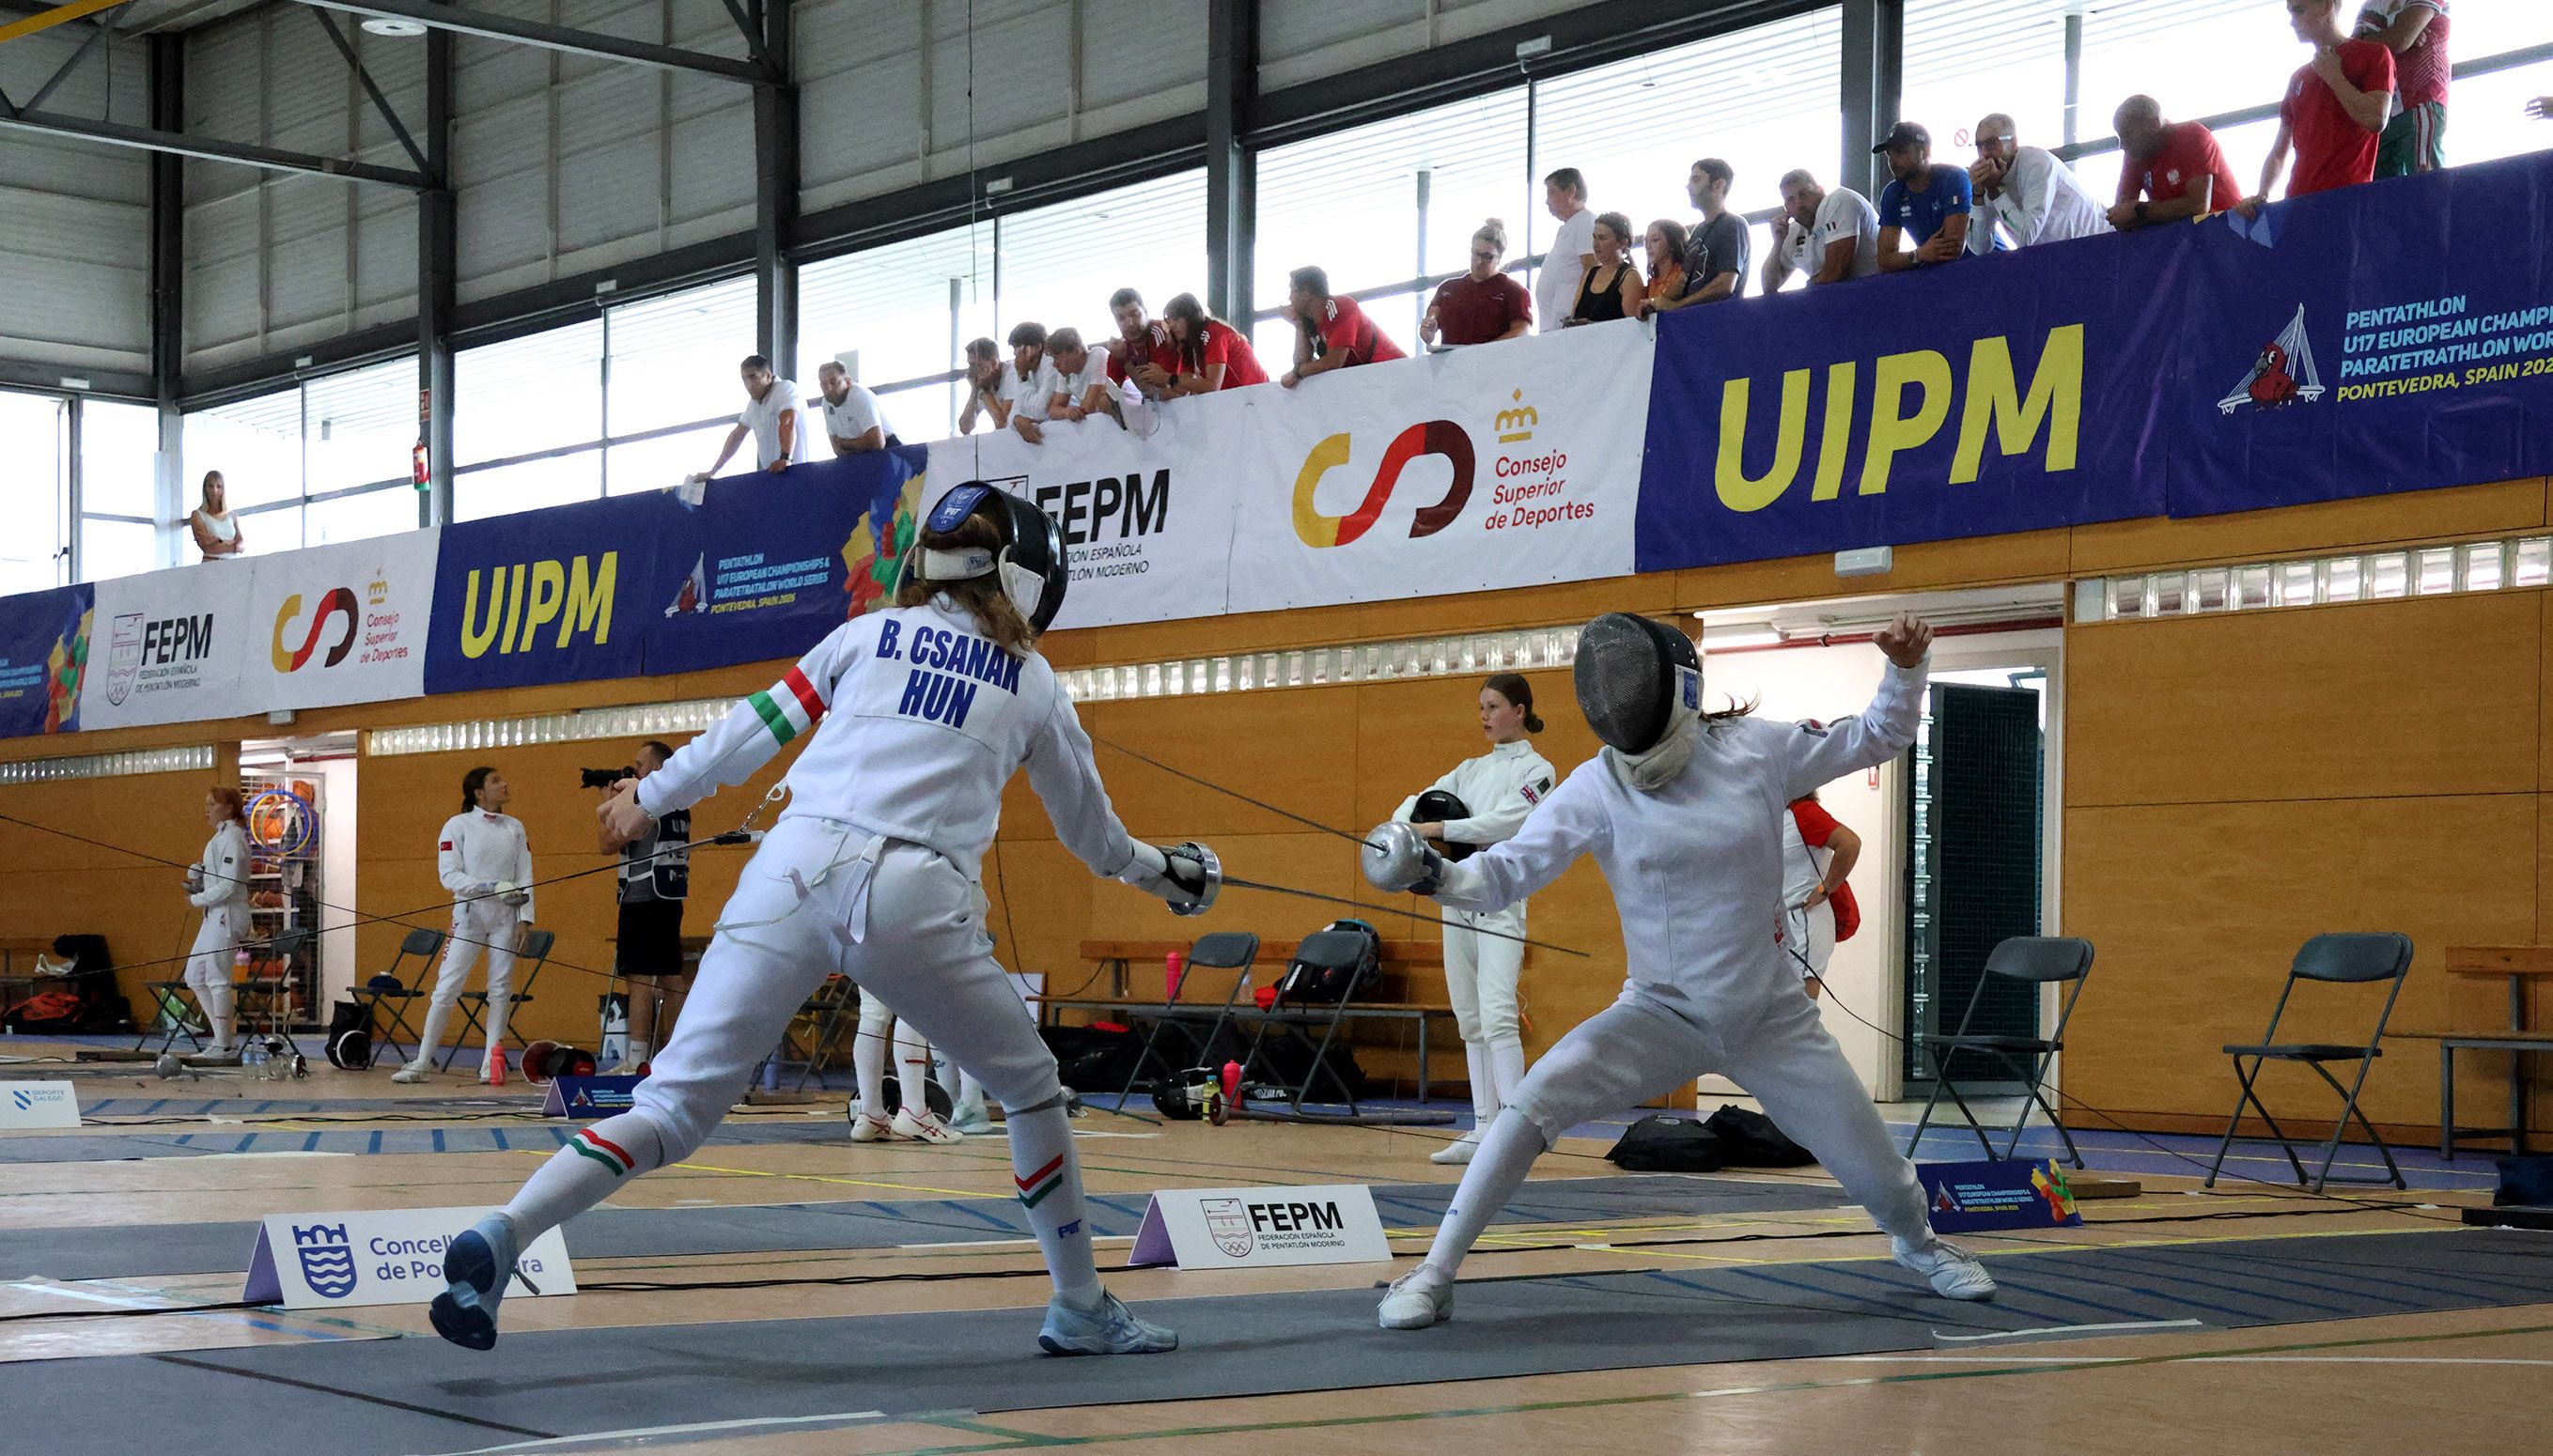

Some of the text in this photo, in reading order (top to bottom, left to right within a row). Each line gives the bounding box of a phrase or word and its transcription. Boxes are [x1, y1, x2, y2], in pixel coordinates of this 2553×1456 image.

[2345, 295, 2467, 330] PENTATHLON
[2343, 333, 2376, 354] U17
[2377, 318, 2479, 350] EUROPEAN
[2340, 336, 2510, 378] PARATETRATHLON
[2337, 372, 2460, 402] PONTEVEDRA,
[2464, 363, 2519, 386] SPAIN
[1714, 323, 2084, 513] UIPM
[1495, 448, 1567, 478] Consejo
[1492, 476, 1566, 506] Superior
[1485, 500, 1596, 531] de Deportes
[1090, 542, 1143, 561] ESPAÑOLA
[1096, 560, 1150, 579] MODERNO
[460, 551, 618, 658] UIPM
[141, 612, 214, 667] FEPM
[876, 618, 1026, 697] B. CSANAK
[898, 669, 978, 729] HUN
[1248, 1201, 1344, 1231] FEPM
[369, 1234, 453, 1257] Concell
[1258, 1231, 1335, 1241] FEDERACIÓN ESPAÑOLA
[1271, 1241, 1309, 1249] PENTATLÓN
[377, 1262, 406, 1281] de
